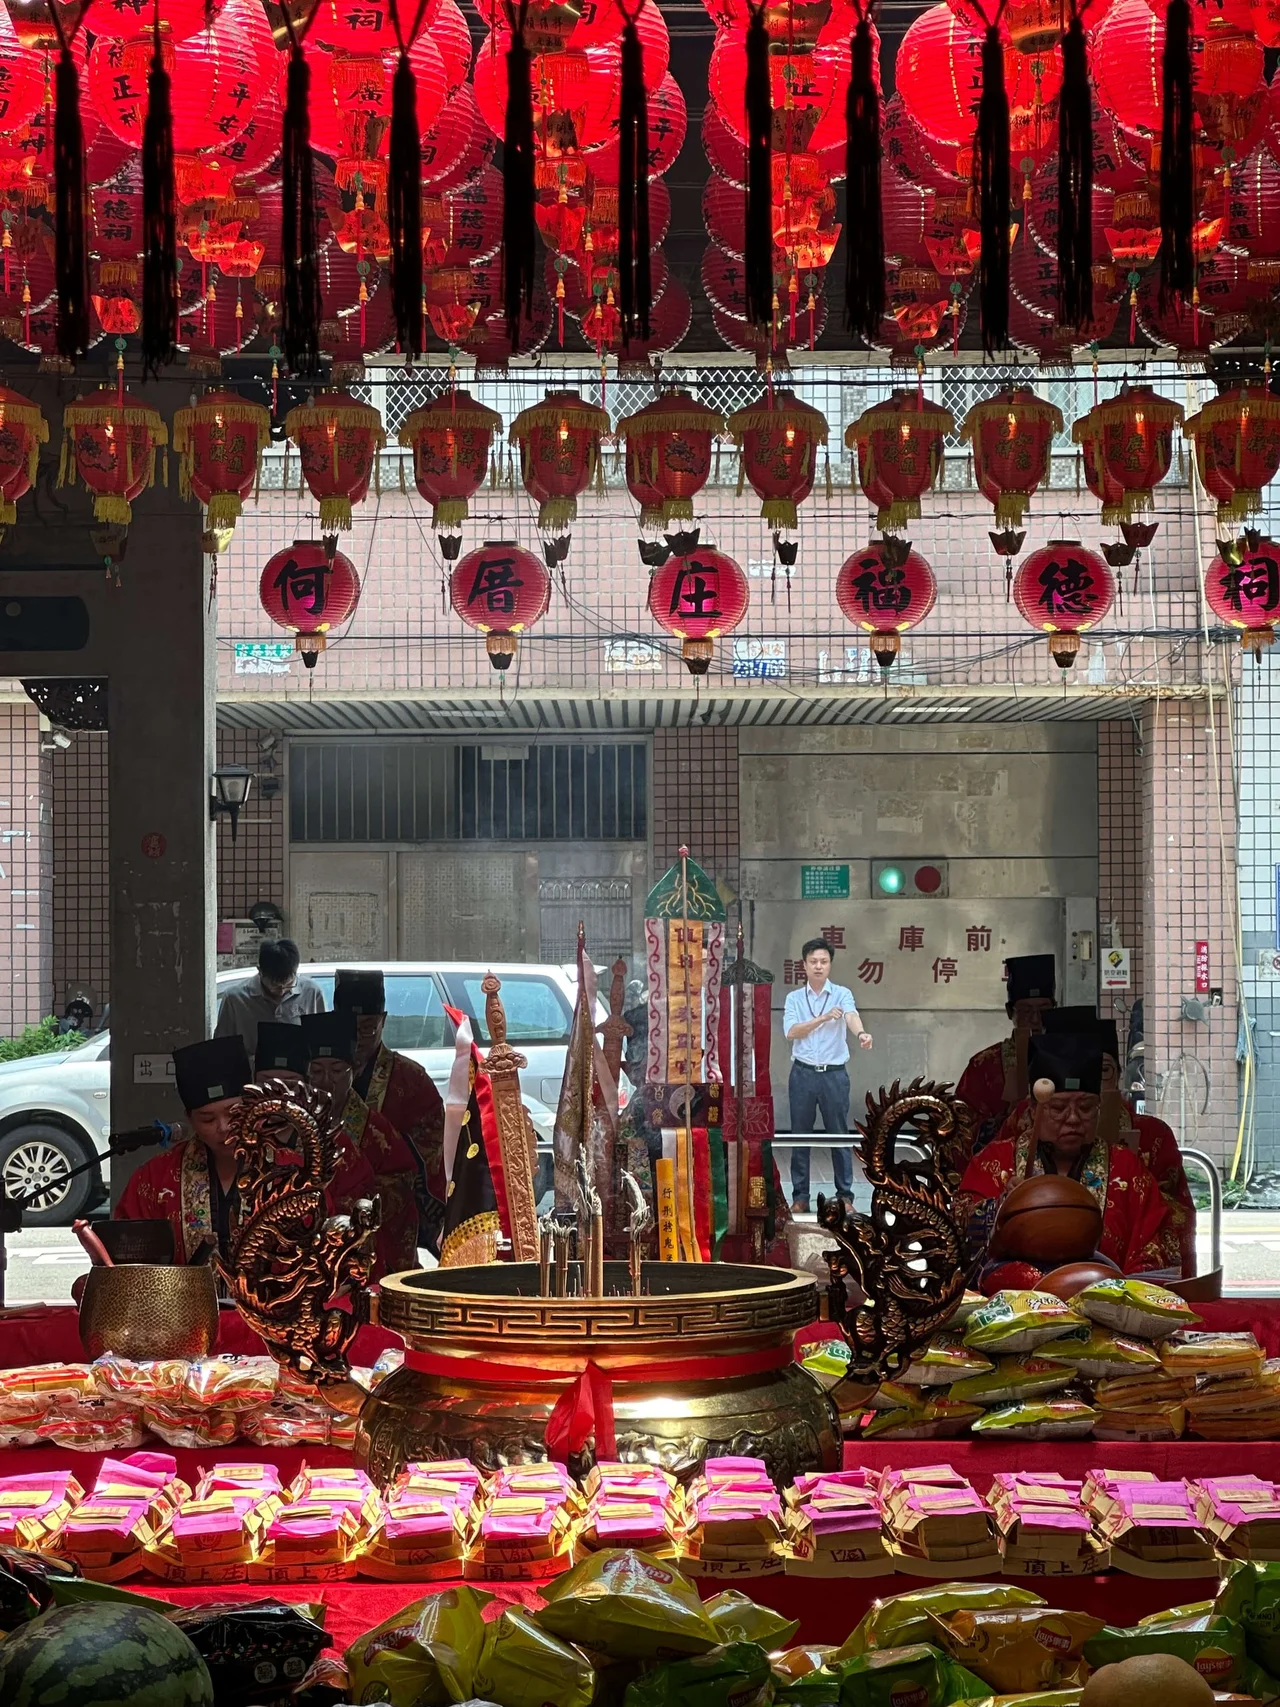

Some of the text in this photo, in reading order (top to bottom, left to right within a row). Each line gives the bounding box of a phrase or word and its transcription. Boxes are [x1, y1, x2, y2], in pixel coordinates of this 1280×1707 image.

[273, 558, 333, 615] 何
[467, 558, 524, 613] 厝
[669, 561, 722, 618] 庄
[852, 558, 911, 616] 福
[1038, 558, 1099, 613] 德
[1219, 557, 1280, 612] 祠
[163, 1562, 245, 1582] 頂上庄
[265, 1562, 347, 1582] 頂上庄
